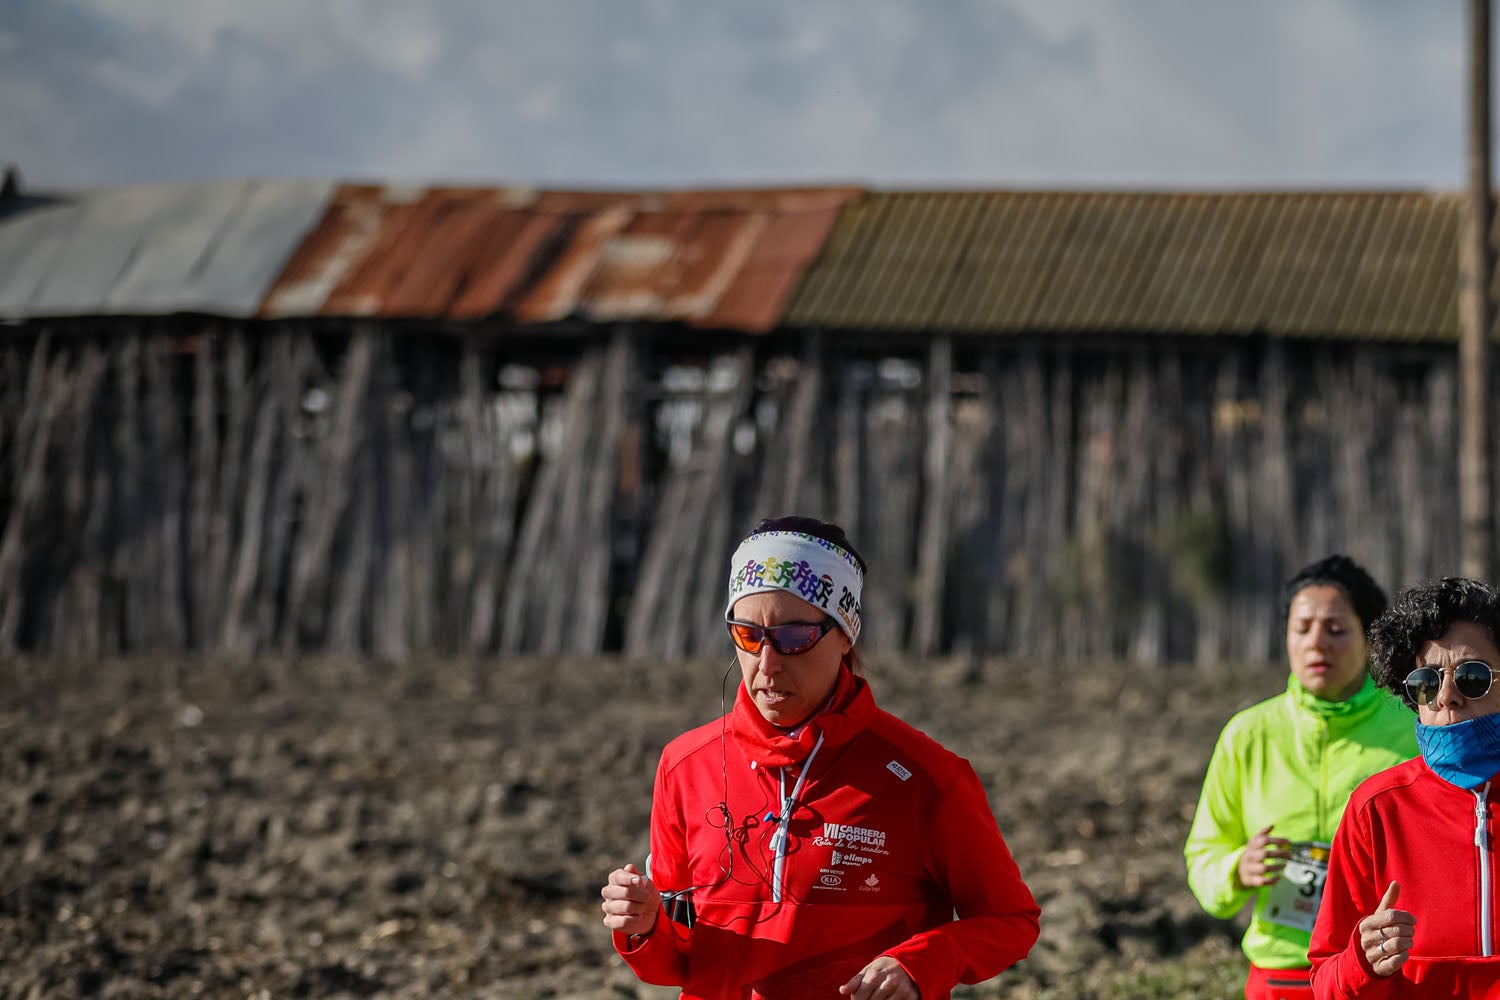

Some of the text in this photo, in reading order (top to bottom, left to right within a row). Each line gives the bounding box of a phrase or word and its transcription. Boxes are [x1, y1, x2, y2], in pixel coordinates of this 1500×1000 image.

[823, 822, 886, 840] VII CARRERA
[838, 832, 885, 847] POPULAR
[843, 853, 873, 865] olimpo
